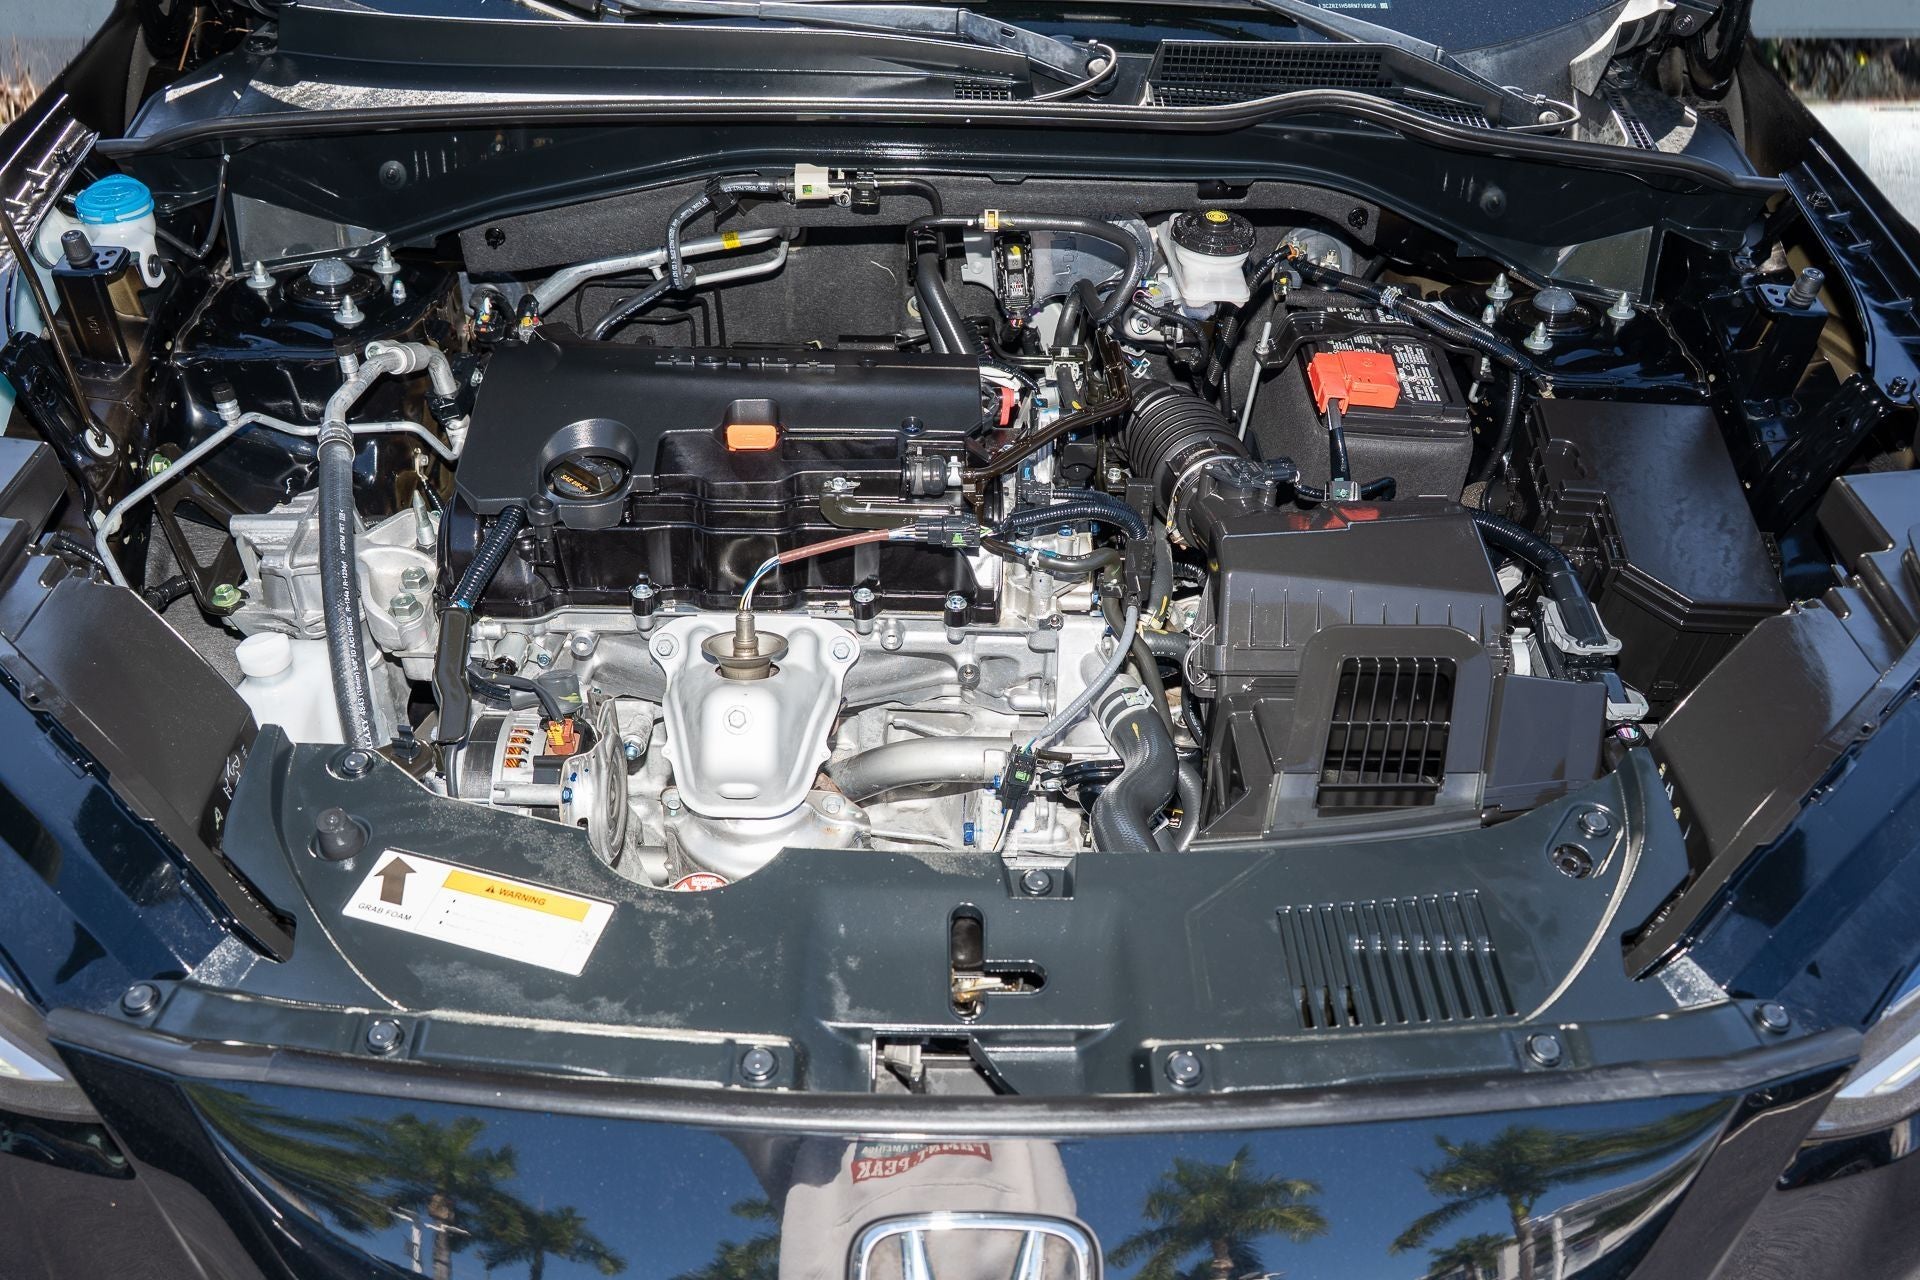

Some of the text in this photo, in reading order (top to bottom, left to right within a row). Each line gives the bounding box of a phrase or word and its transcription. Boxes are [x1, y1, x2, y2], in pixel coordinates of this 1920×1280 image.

[344, 590, 352, 613] R-134a
[350, 650, 357, 658] ID
[357, 697, 366, 716] 4843
[361, 718, 374, 750] ALAXY
[498, 888, 547, 906] WARNING
[358, 902, 412, 921] GRAB FOAM
